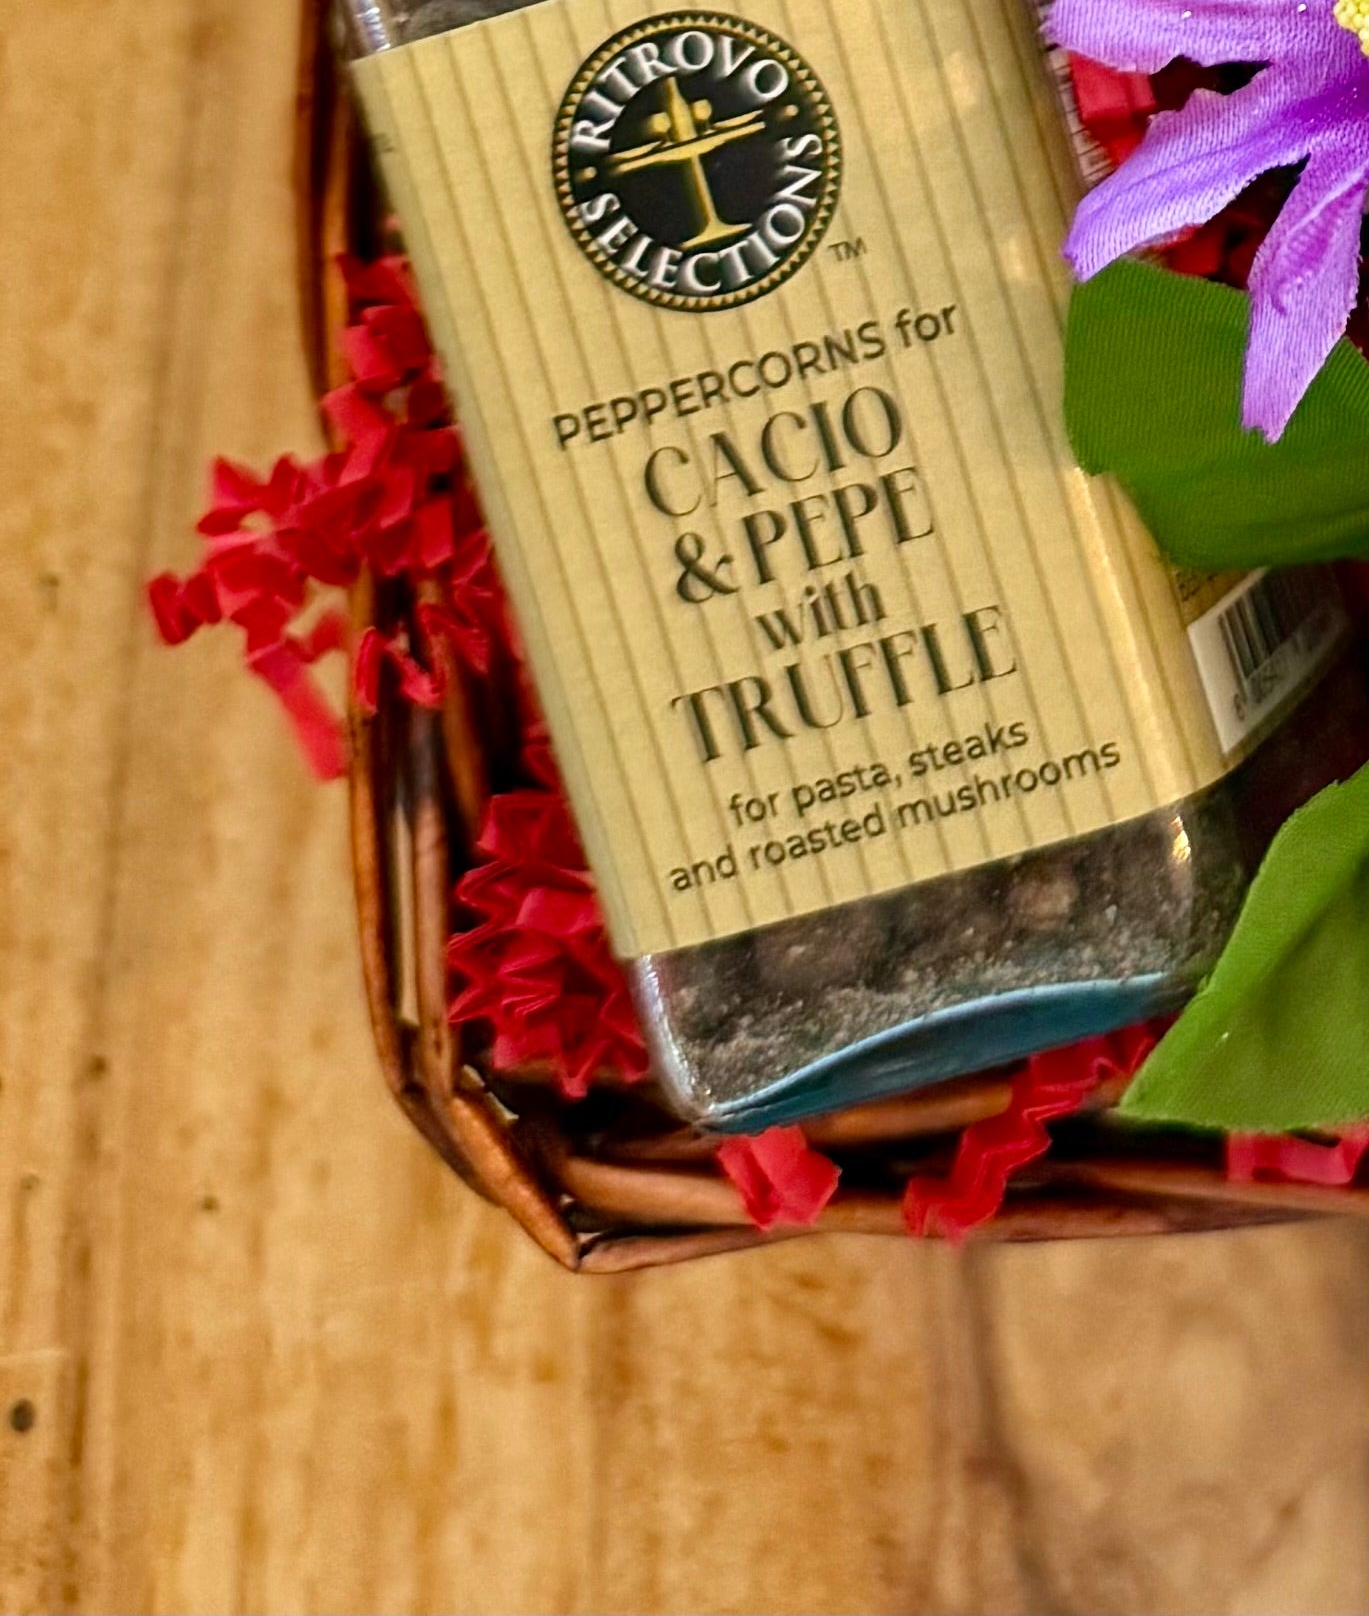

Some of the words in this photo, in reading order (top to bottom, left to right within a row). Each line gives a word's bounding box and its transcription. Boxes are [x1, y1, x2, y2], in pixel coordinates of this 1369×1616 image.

[569, 29, 790, 149] RITROVO
[576, 132, 824, 296] SELECTIONS
[552, 319, 887, 451] PEPPERCORNS
[894, 303, 957, 348] for
[643, 385, 903, 518] CACIO
[674, 531, 740, 604] &
[741, 466, 935, 585] PEPE
[754, 568, 888, 653] with
[670, 604, 1018, 764] TRUFFLE
[668, 844, 738, 893] and
[749, 795, 888, 871] roasted
[897, 738, 1123, 829] mushrooms
[728, 791, 782, 827] for
[791, 757, 903, 820] pasta,
[906, 717, 1030, 778] steaks
